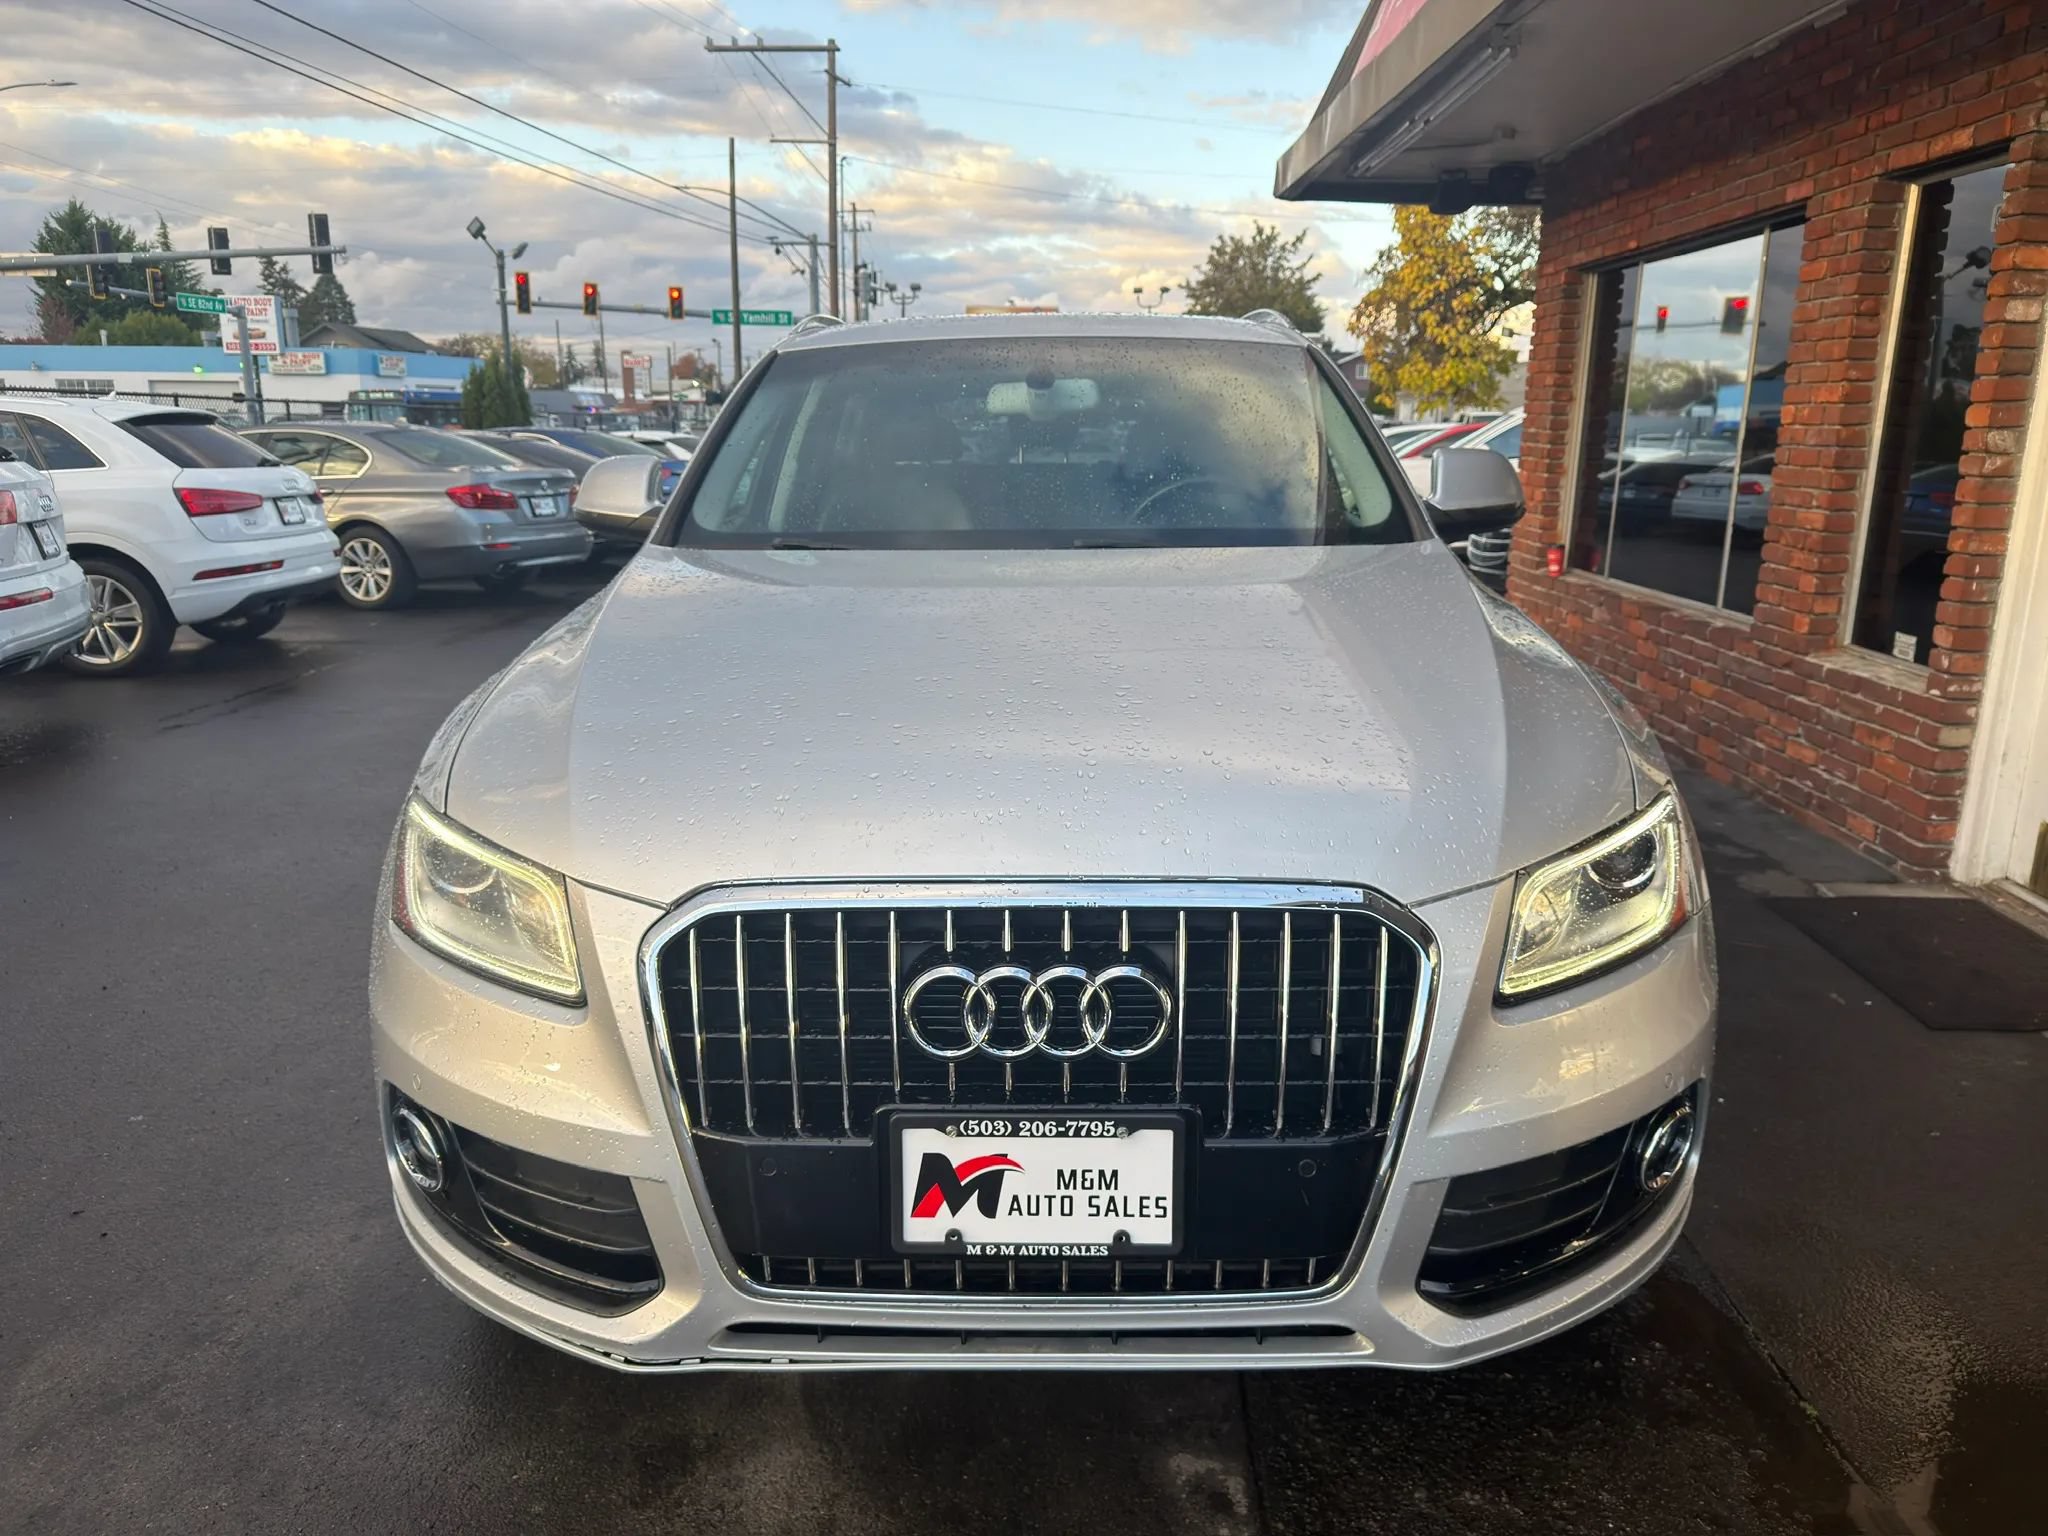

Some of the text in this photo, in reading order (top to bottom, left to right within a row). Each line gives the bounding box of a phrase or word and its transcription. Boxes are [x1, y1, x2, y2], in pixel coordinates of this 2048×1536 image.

[188, 298, 196, 308] SE
[198, 299, 213, 309] 82nd
[215, 300, 223, 311] Av
[233, 298, 252, 306] AUTO
[253, 298, 272, 306] BODY
[742, 312, 776, 323] Yamhill
[778, 313, 788, 324] St
[959, 1120, 1116, 1138] (503) 206-7795
[1056, 1169, 1119, 1191] M&M
[1007, 1194, 1168, 1219] AUTO SALES
[966, 1245, 1109, 1256] M & M AUTO SALES
